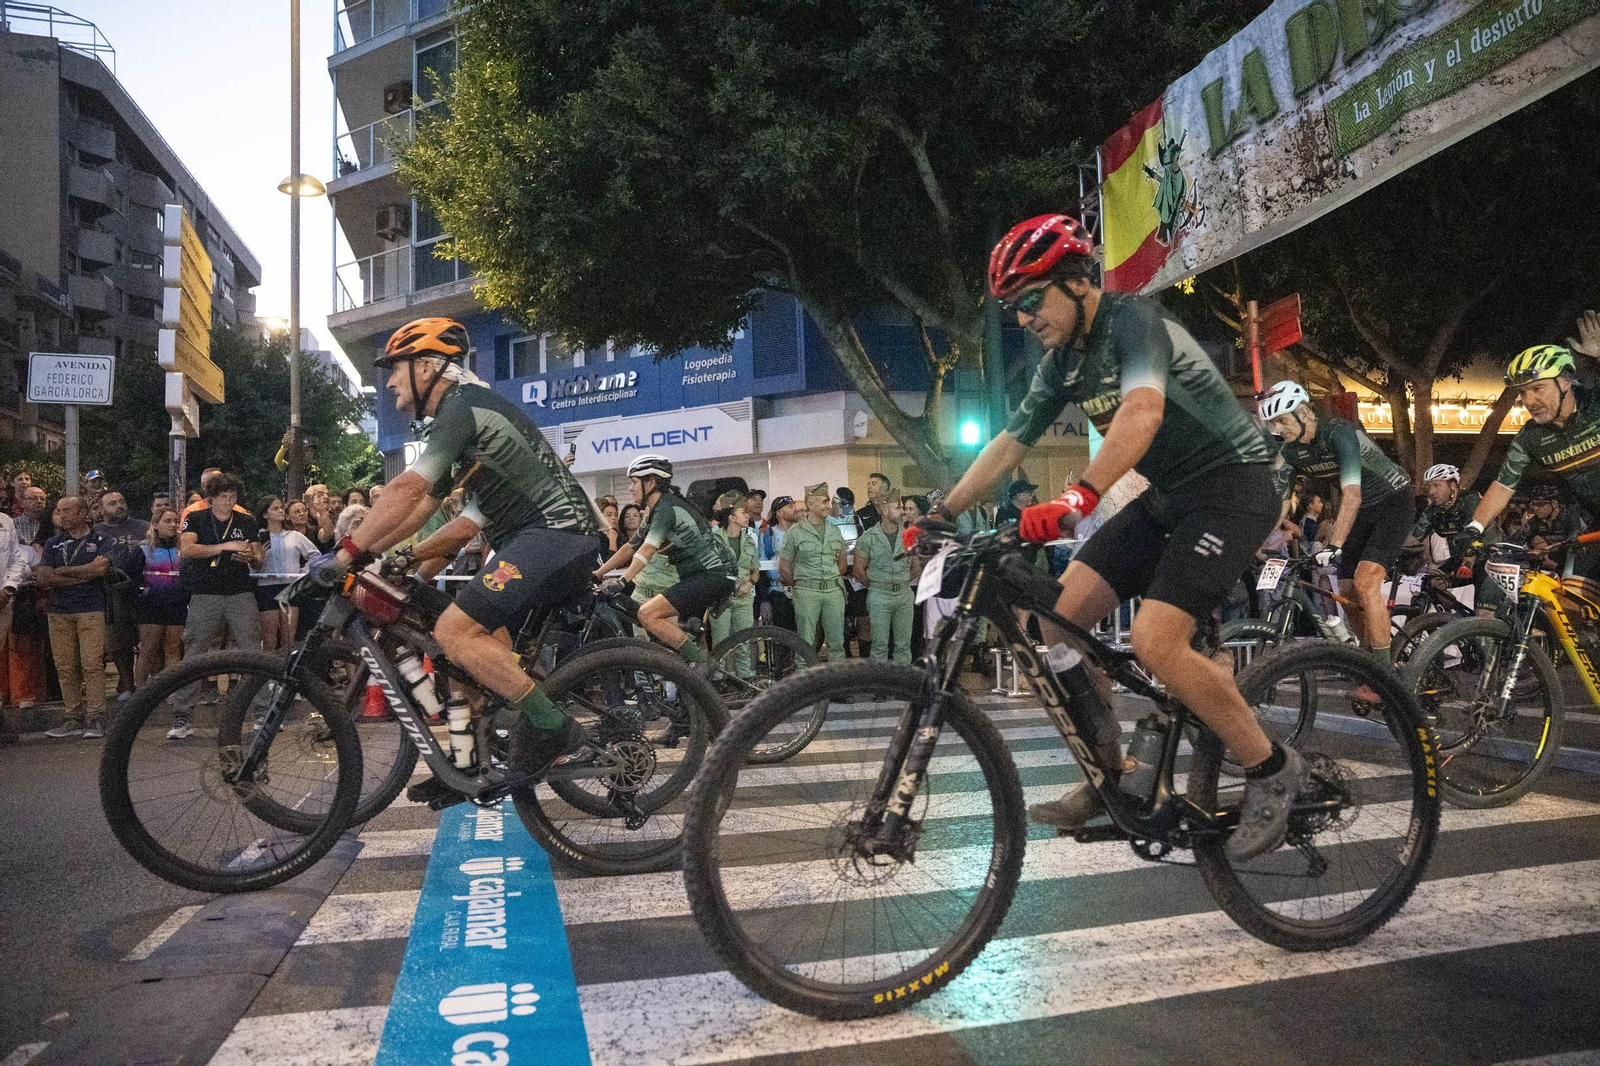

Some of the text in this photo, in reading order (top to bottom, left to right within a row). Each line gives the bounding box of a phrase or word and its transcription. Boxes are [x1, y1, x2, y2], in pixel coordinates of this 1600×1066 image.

[1353, 0, 1544, 124] La Legión y el desierto
[1201, 46, 1279, 160] LA
[47, 373, 94, 386] FEDERICO
[55, 361, 107, 370] AVENIDA
[682, 369, 737, 386] Fisioterapia
[684, 353, 733, 371] Logopedia
[34, 385, 104, 399] GARCÍA LORCA
[551, 389, 638, 410] Centro Interdisciplinar
[591, 425, 714, 454] VITALDENT
[1556, 610, 1600, 696] LAPIERR
[360, 646, 434, 755] SPECIALIZED
[1012, 643, 1105, 789] ORBEA
[1417, 727, 1437, 797] MAXXIS
[549, 835, 583, 861] RENEGADE
[452, 877, 522, 950] cajamar
[873, 961, 949, 1004] MAXXIS
